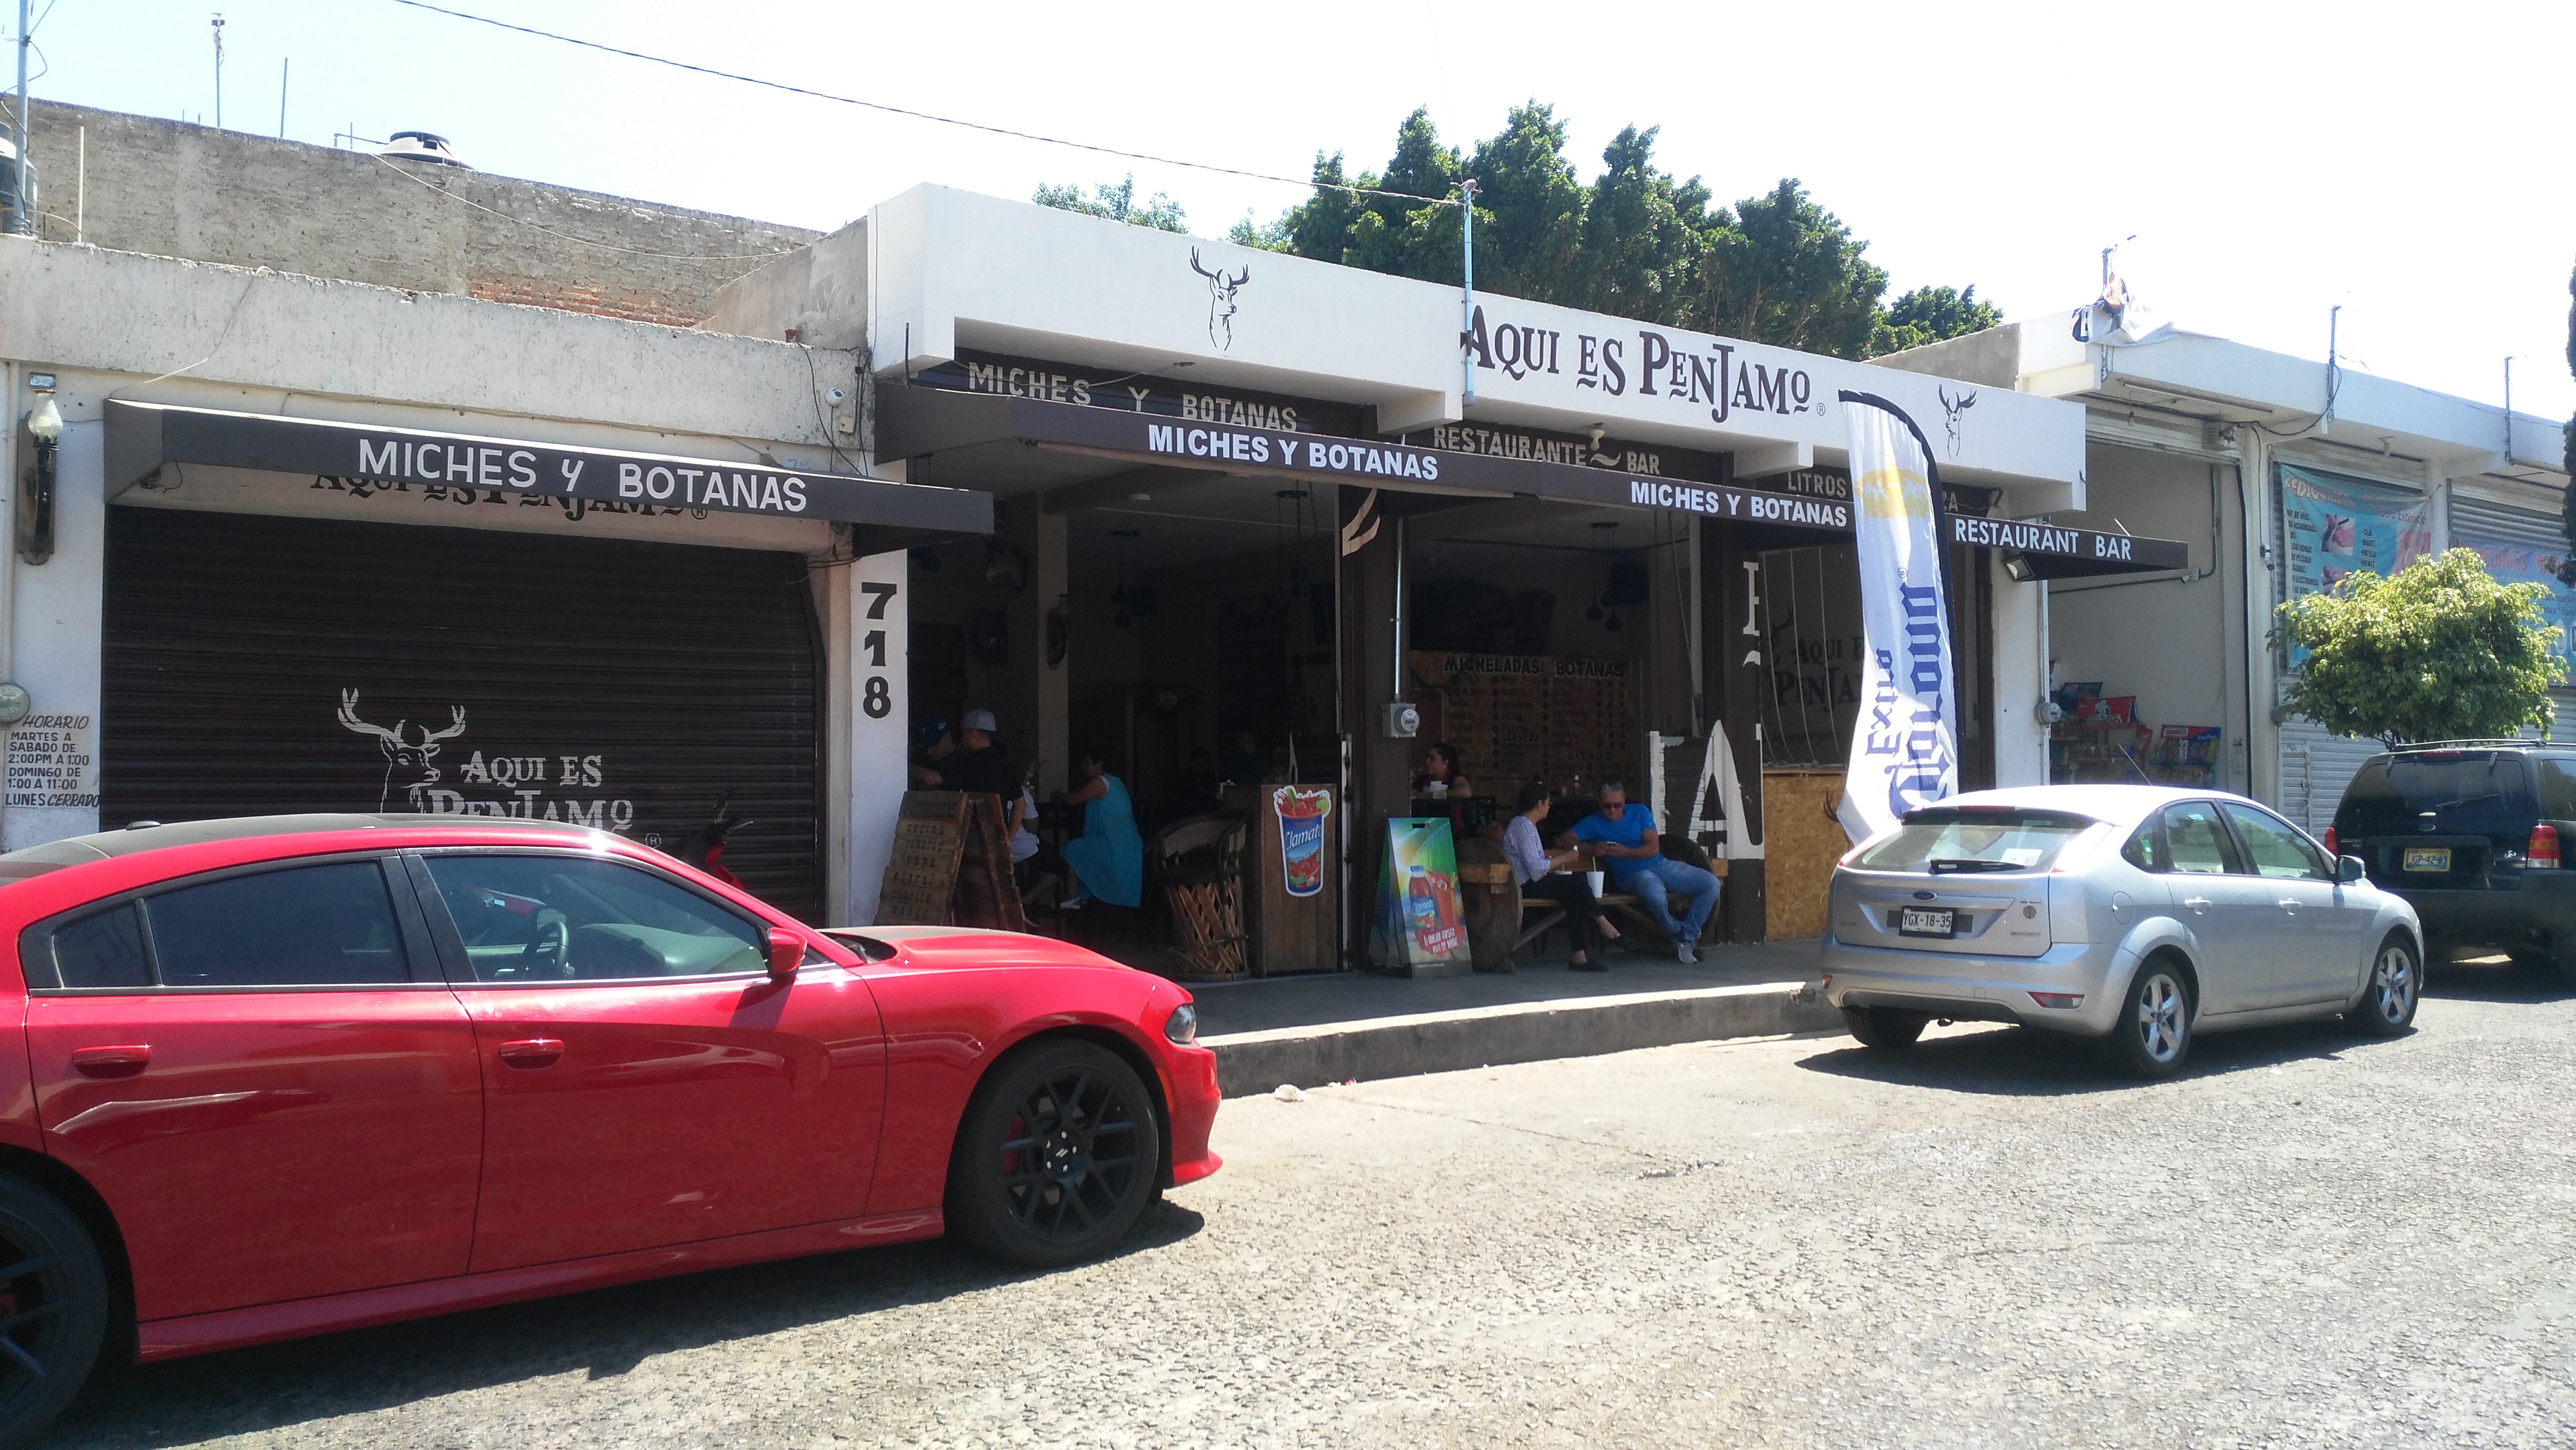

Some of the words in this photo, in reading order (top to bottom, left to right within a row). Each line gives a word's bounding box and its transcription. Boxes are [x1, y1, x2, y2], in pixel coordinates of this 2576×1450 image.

[1461, 304, 1560, 381] AQUI
[1576, 334, 1626, 397] ES
[1639, 331, 1811, 423] PENJAMO
[968, 362, 1092, 406] MICHES
[1127, 386, 1150, 413] Y
[1183, 393, 1298, 433] BOTANAS
[1148, 424, 1270, 463] MICHES
[1278, 439, 1300, 466] Y
[1309, 442, 1439, 481] BOTANAS
[1432, 426, 1586, 467] RESTAURANTE
[1626, 451, 1661, 476] BAR
[359, 438, 537, 488] MICHES
[620, 463, 807, 511] BOTANAS
[1788, 471, 1847, 498] LITROS
[1631, 481, 1719, 514] MICHES
[1726, 493, 1742, 516] Y
[1751, 496, 1847, 528] BOTANAS
[1955, 518, 2080, 554] RESTAURANT
[2095, 535, 2132, 560] BAR
[1556, 660, 1625, 677] BOTANAS
[1865, 647, 1903, 757] Extra
[23, 715, 89, 729] HORARIO
[9, 742, 58, 753] SABADO
[62, 743, 76, 753] DE
[11, 732, 59, 742] MARTES
[63, 732, 72, 742] A
[8, 754, 51, 764] 2:00PM
[56, 754, 64, 765] A
[1568, 751, 1611, 761] LITROS
[9, 767, 62, 778] DOMINGO
[67, 767, 81, 777] DE
[460, 751, 547, 787] AQUI
[560, 754, 602, 787] ES
[34, 779, 42, 789] A
[5, 793, 46, 806] LUNES
[47, 793, 100, 808] CERRADO
[1904, 912, 1952, 928] YGX-18-35
